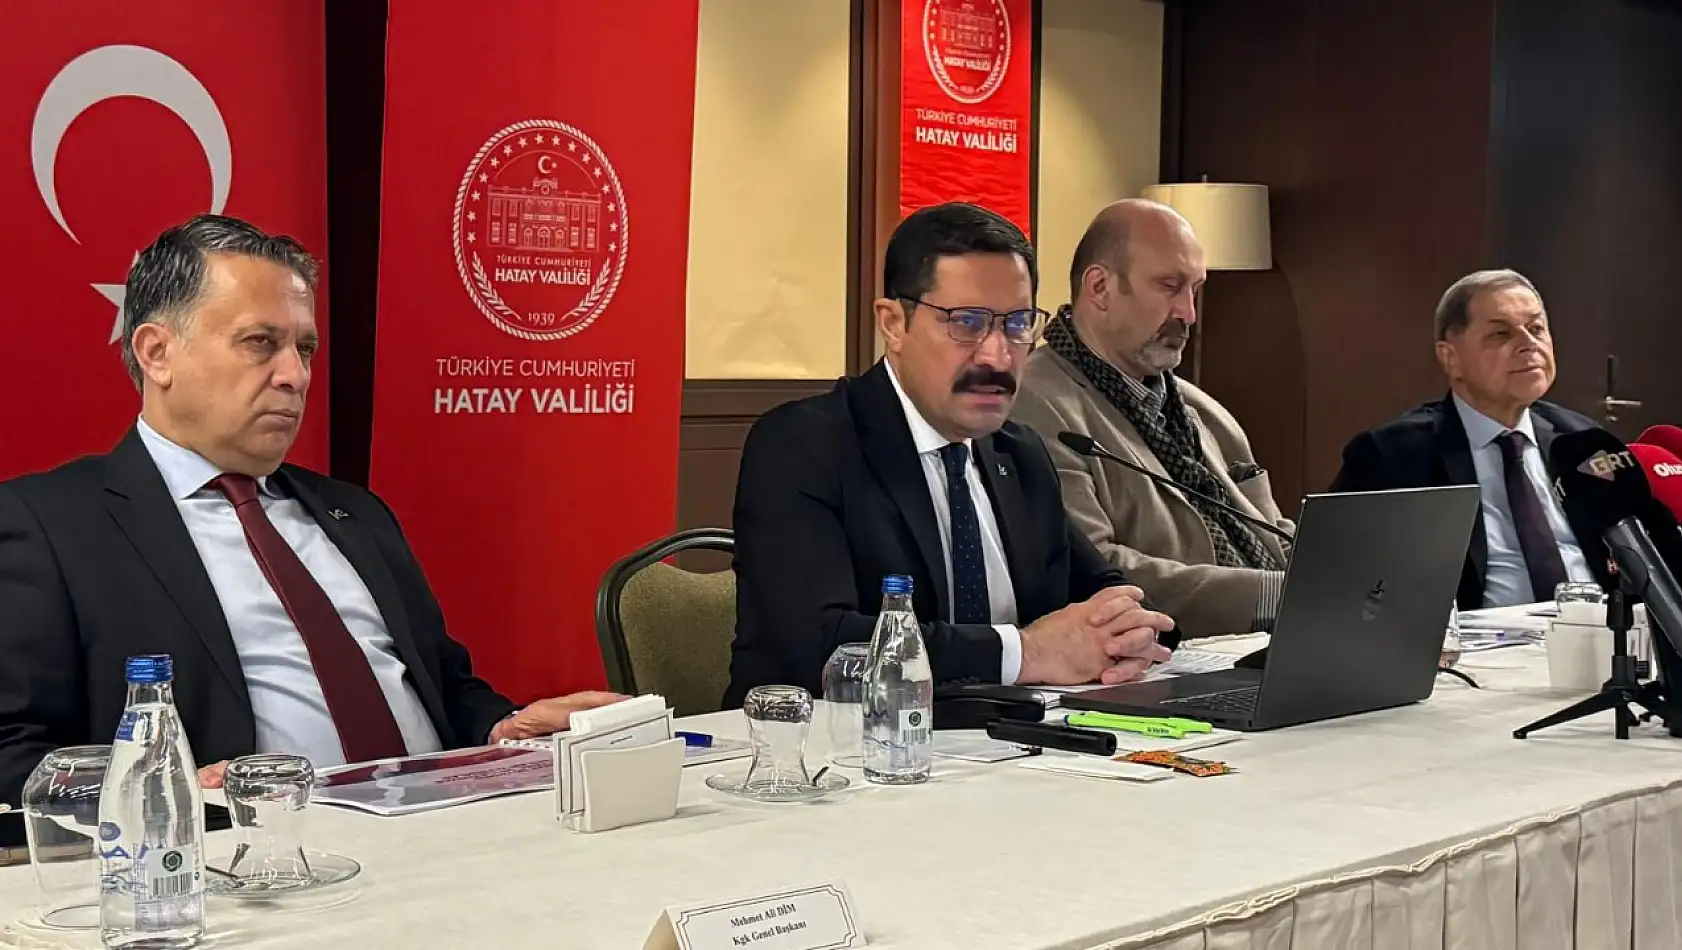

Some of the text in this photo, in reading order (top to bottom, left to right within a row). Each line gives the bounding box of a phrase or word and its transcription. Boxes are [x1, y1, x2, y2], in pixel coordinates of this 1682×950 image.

[915, 107, 955, 124] TÜRKİYE
[916, 126, 1017, 153] HATAY VALİLİĞİ
[497, 253, 530, 265] TÜRKİYE
[495, 267, 591, 286] HATAY VALİLİĞİ
[528, 312, 555, 326] 1939
[437, 356, 635, 377] TÜRKİYE CUMHURİYETİ
[434, 383, 635, 414] HATAY VALİLİĞİ
[731, 913, 763, 928] Mehmet
[764, 908, 776, 919] Ali
[751, 927, 775, 941] Genel
[775, 920, 807, 934] Başkanı
